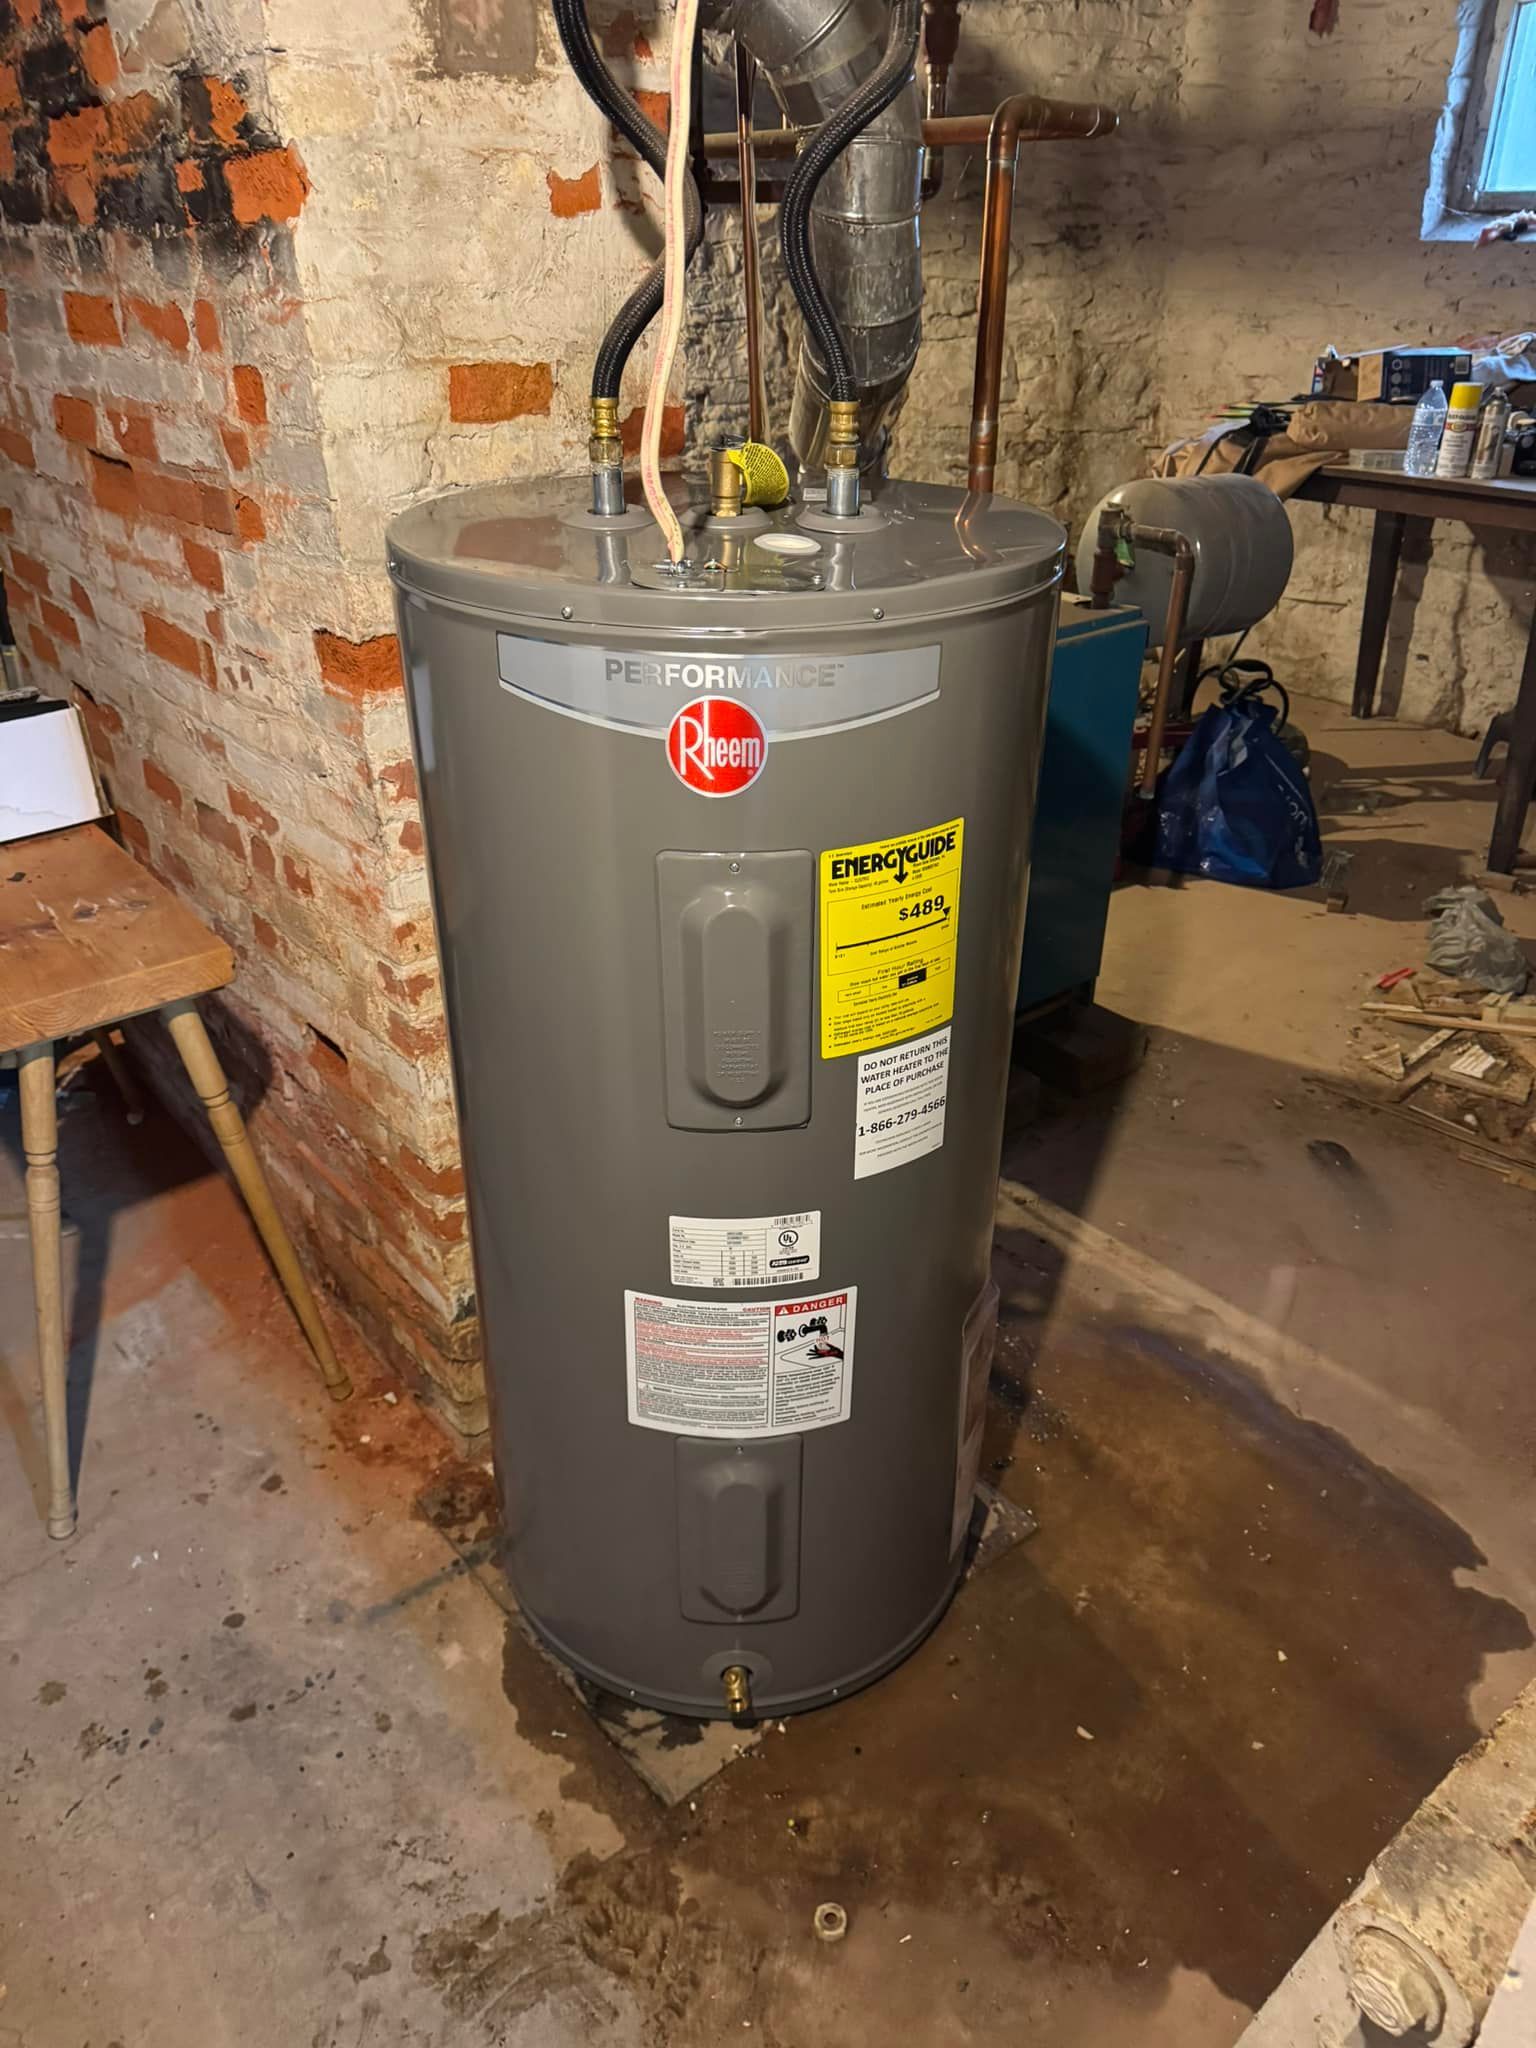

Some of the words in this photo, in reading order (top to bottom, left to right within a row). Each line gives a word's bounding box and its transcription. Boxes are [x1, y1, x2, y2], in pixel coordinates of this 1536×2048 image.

[679, 699, 760, 780] Rheem
[831, 831, 957, 881] ENERGYGUIDE
[898, 895, 945, 921] $489
[860, 1069, 891, 1084] WATER
[892, 1059, 922, 1076] HEATER
[924, 1054, 934, 1064] TO
[935, 1047, 949, 1059] THE
[863, 1061, 878, 1072] DO
[879, 1055, 897, 1067] NOT
[899, 1045, 931, 1061] RETURN
[932, 1036, 948, 1048] THIS
[864, 1082, 891, 1095] PLACE
[893, 1076, 904, 1087] OF
[905, 1061, 945, 1083] PURCHASE
[858, 1095, 946, 1137] 1-866-279-4566
[792, 1296, 843, 1312] DANGER
